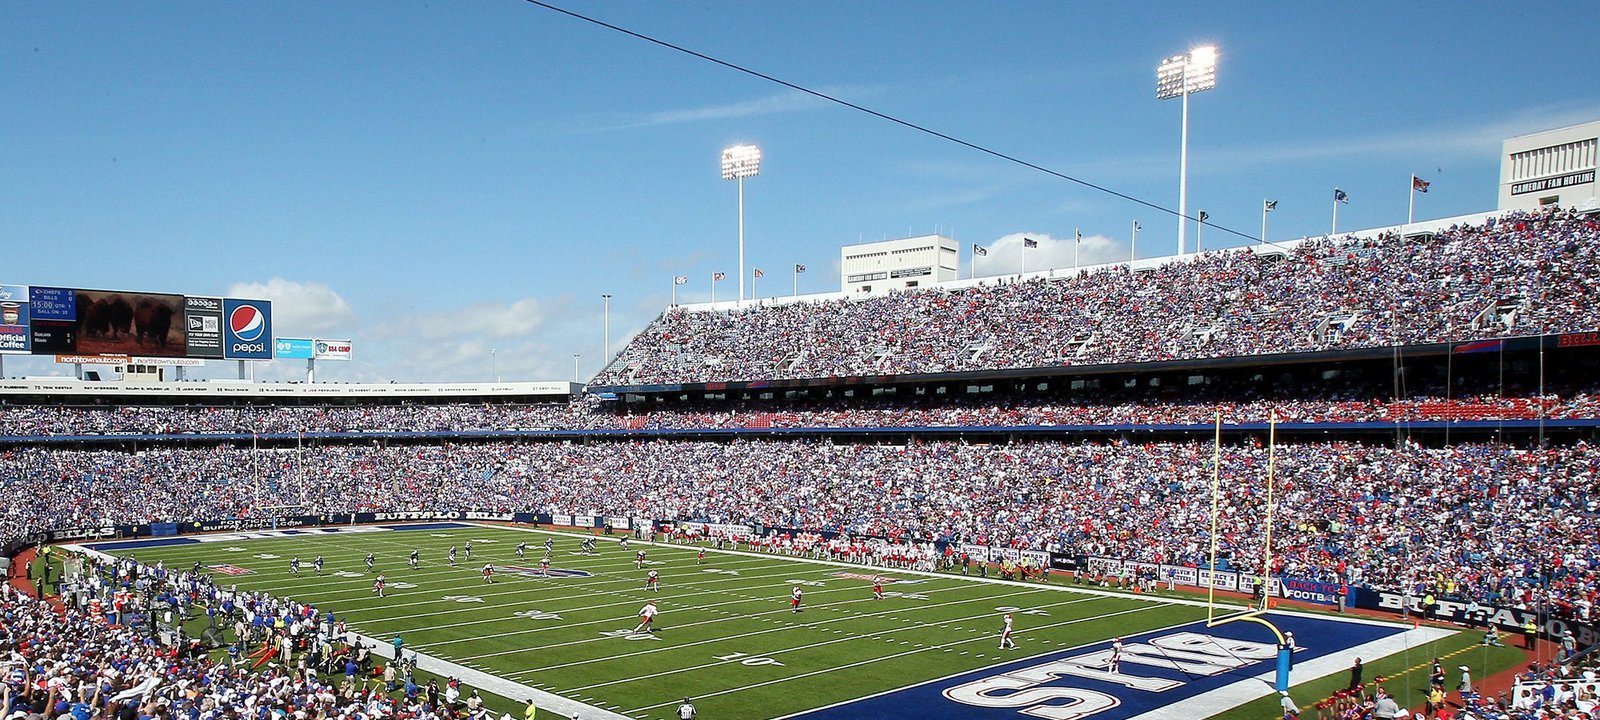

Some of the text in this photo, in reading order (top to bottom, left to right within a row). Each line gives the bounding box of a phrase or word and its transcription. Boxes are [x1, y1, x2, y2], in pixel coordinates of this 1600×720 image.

[1512, 172, 1594, 194] GAMEDAY FAN HOTLINE
[0, 333, 26, 342] Official
[0, 341, 25, 349] Coffee
[61, 356, 128, 364] northtownauto.com
[137, 358, 200, 366] northtownauto.com
[375, 511, 515, 521] BUFFALO BILLS
[53, 527, 115, 539] BILLS
[1289, 581, 1317, 591] BACK
[1322, 584, 1335, 593] TO
[1288, 589, 1339, 603] FOOTBL
[1379, 592, 1568, 638] BUFFALO
[712, 651, 777, 665] 10
